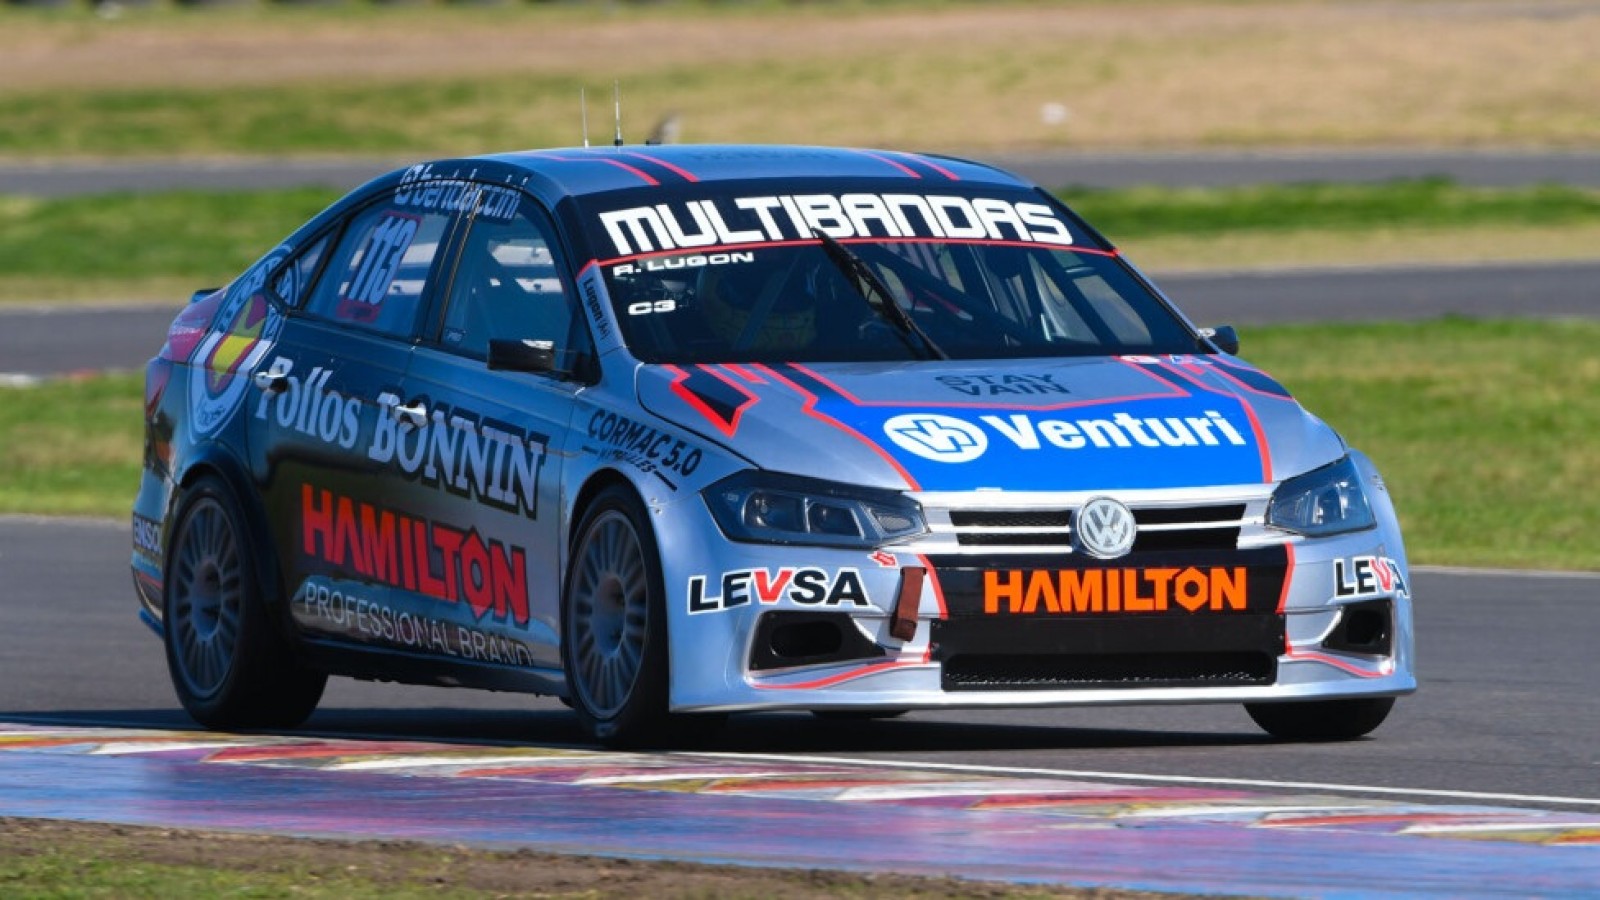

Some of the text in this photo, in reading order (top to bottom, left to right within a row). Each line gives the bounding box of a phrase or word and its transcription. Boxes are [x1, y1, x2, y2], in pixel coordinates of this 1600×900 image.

[599, 194, 1073, 255] MULTIBANDAS
[348, 216, 418, 305] 113
[647, 252, 753, 272] LUGON
[628, 300, 676, 315] C3
[935, 373, 1054, 386] STAY
[950, 384, 1071, 396] VAIN
[255, 356, 547, 515] Pollos BONNIN
[588, 408, 672, 458] CORMAC
[979, 410, 1247, 451] Venturi
[302, 483, 530, 624] HAMILTON
[687, 567, 873, 615] LEVSA
[984, 566, 1247, 613] HAMILTON
[305, 582, 534, 667] PROFESSIONAL BRAND
